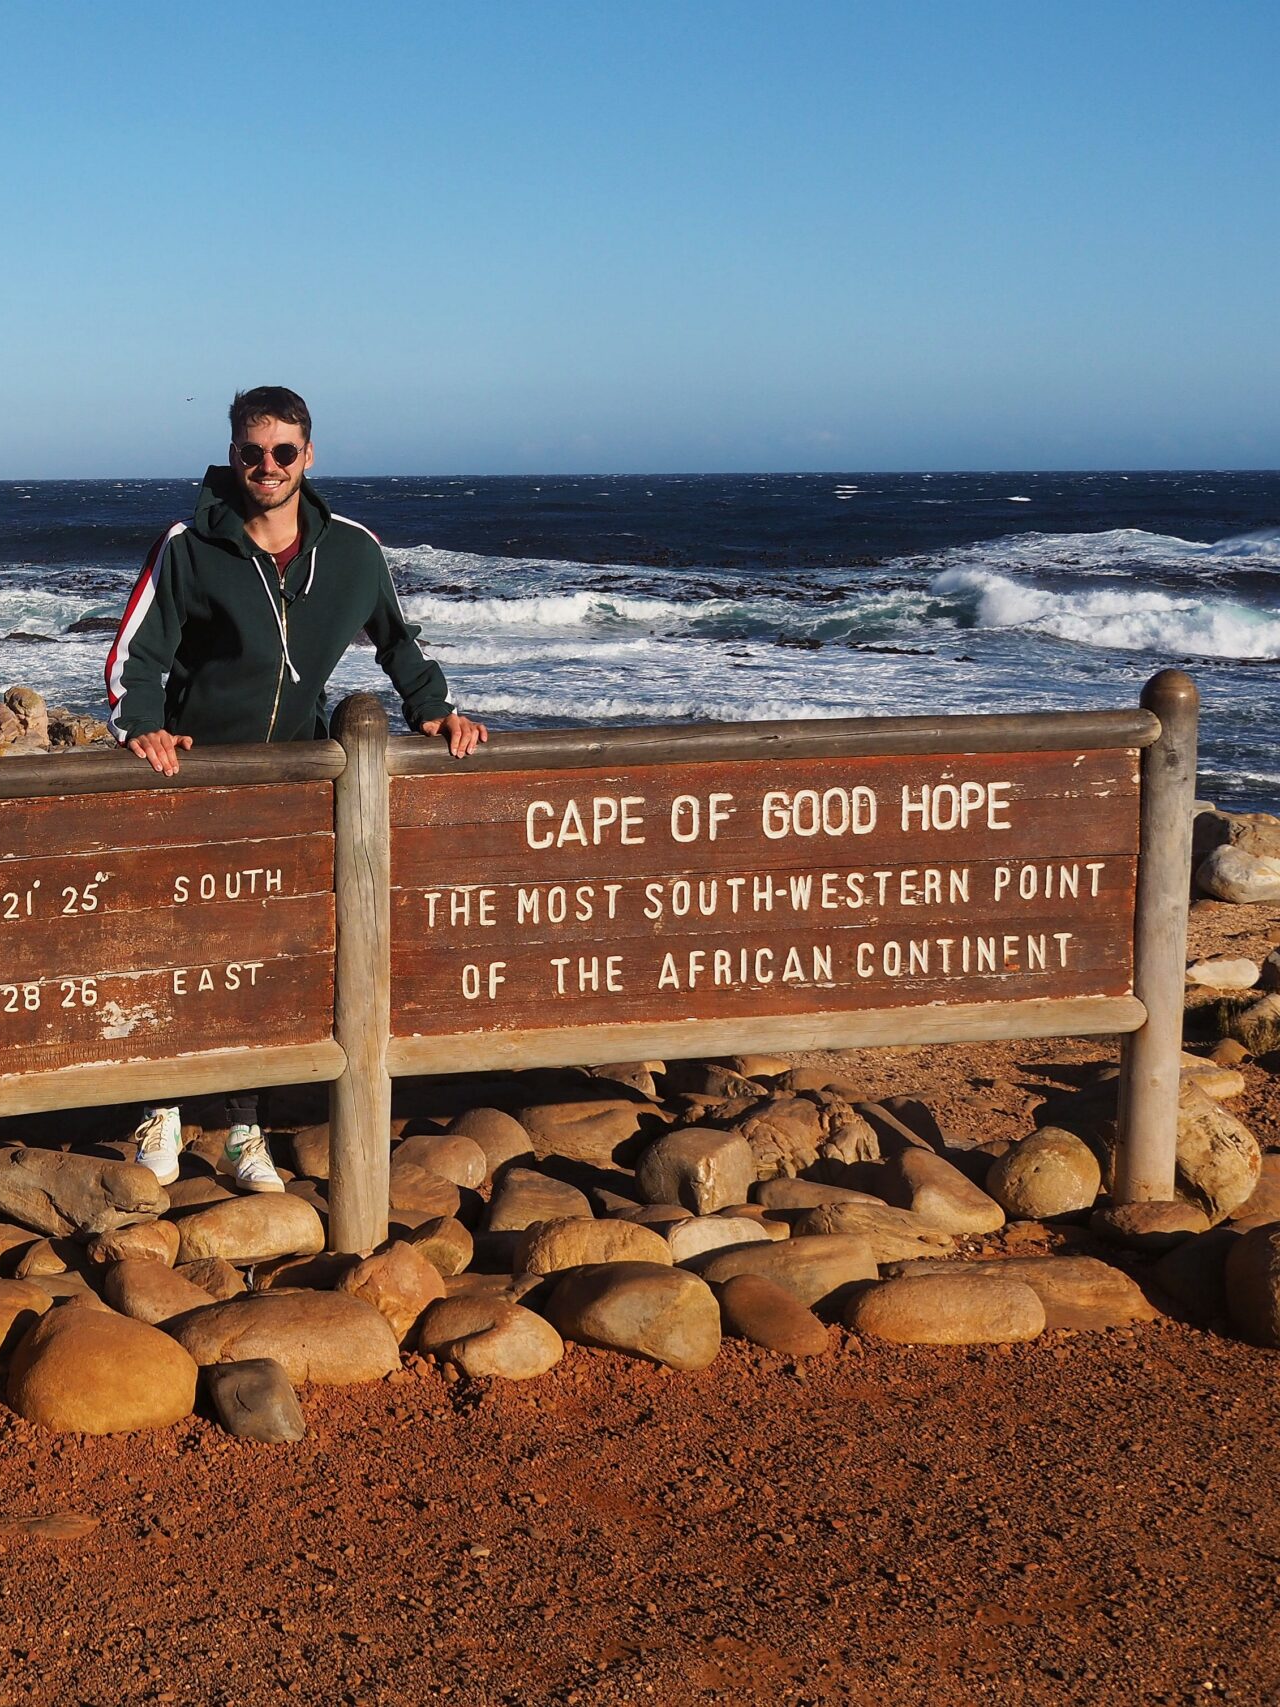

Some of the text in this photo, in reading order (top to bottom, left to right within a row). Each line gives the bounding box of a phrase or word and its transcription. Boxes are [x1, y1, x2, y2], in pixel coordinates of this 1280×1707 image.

[526, 781, 1013, 849] CAPE OF GOOD HOPE
[174, 869, 282, 903] SOUTH
[425, 863, 1105, 928] THE MOST SOUTH-WESTERN POINT
[174, 963, 264, 995] EAST
[462, 932, 1073, 1000] OF THE AFRICAN CONTINENT
